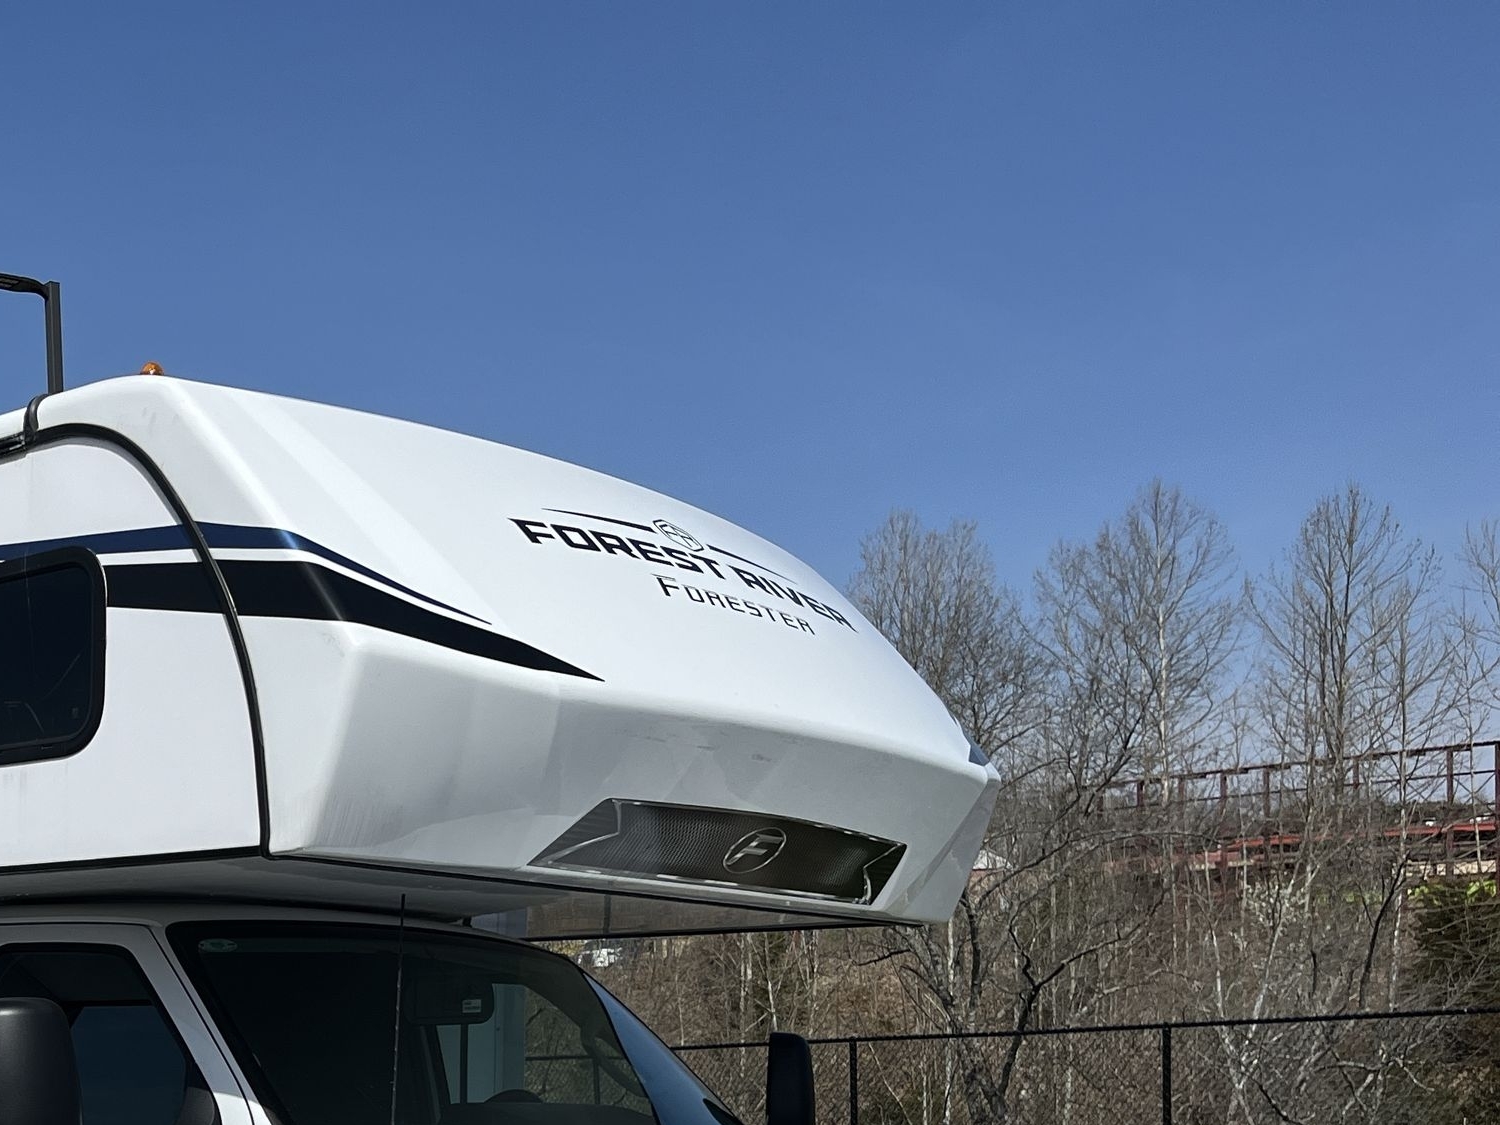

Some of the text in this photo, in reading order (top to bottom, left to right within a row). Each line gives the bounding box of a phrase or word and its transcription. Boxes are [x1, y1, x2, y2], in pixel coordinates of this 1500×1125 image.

[508, 518, 858, 633] FOREST RIVER
[650, 573, 816, 635] FORESTER
